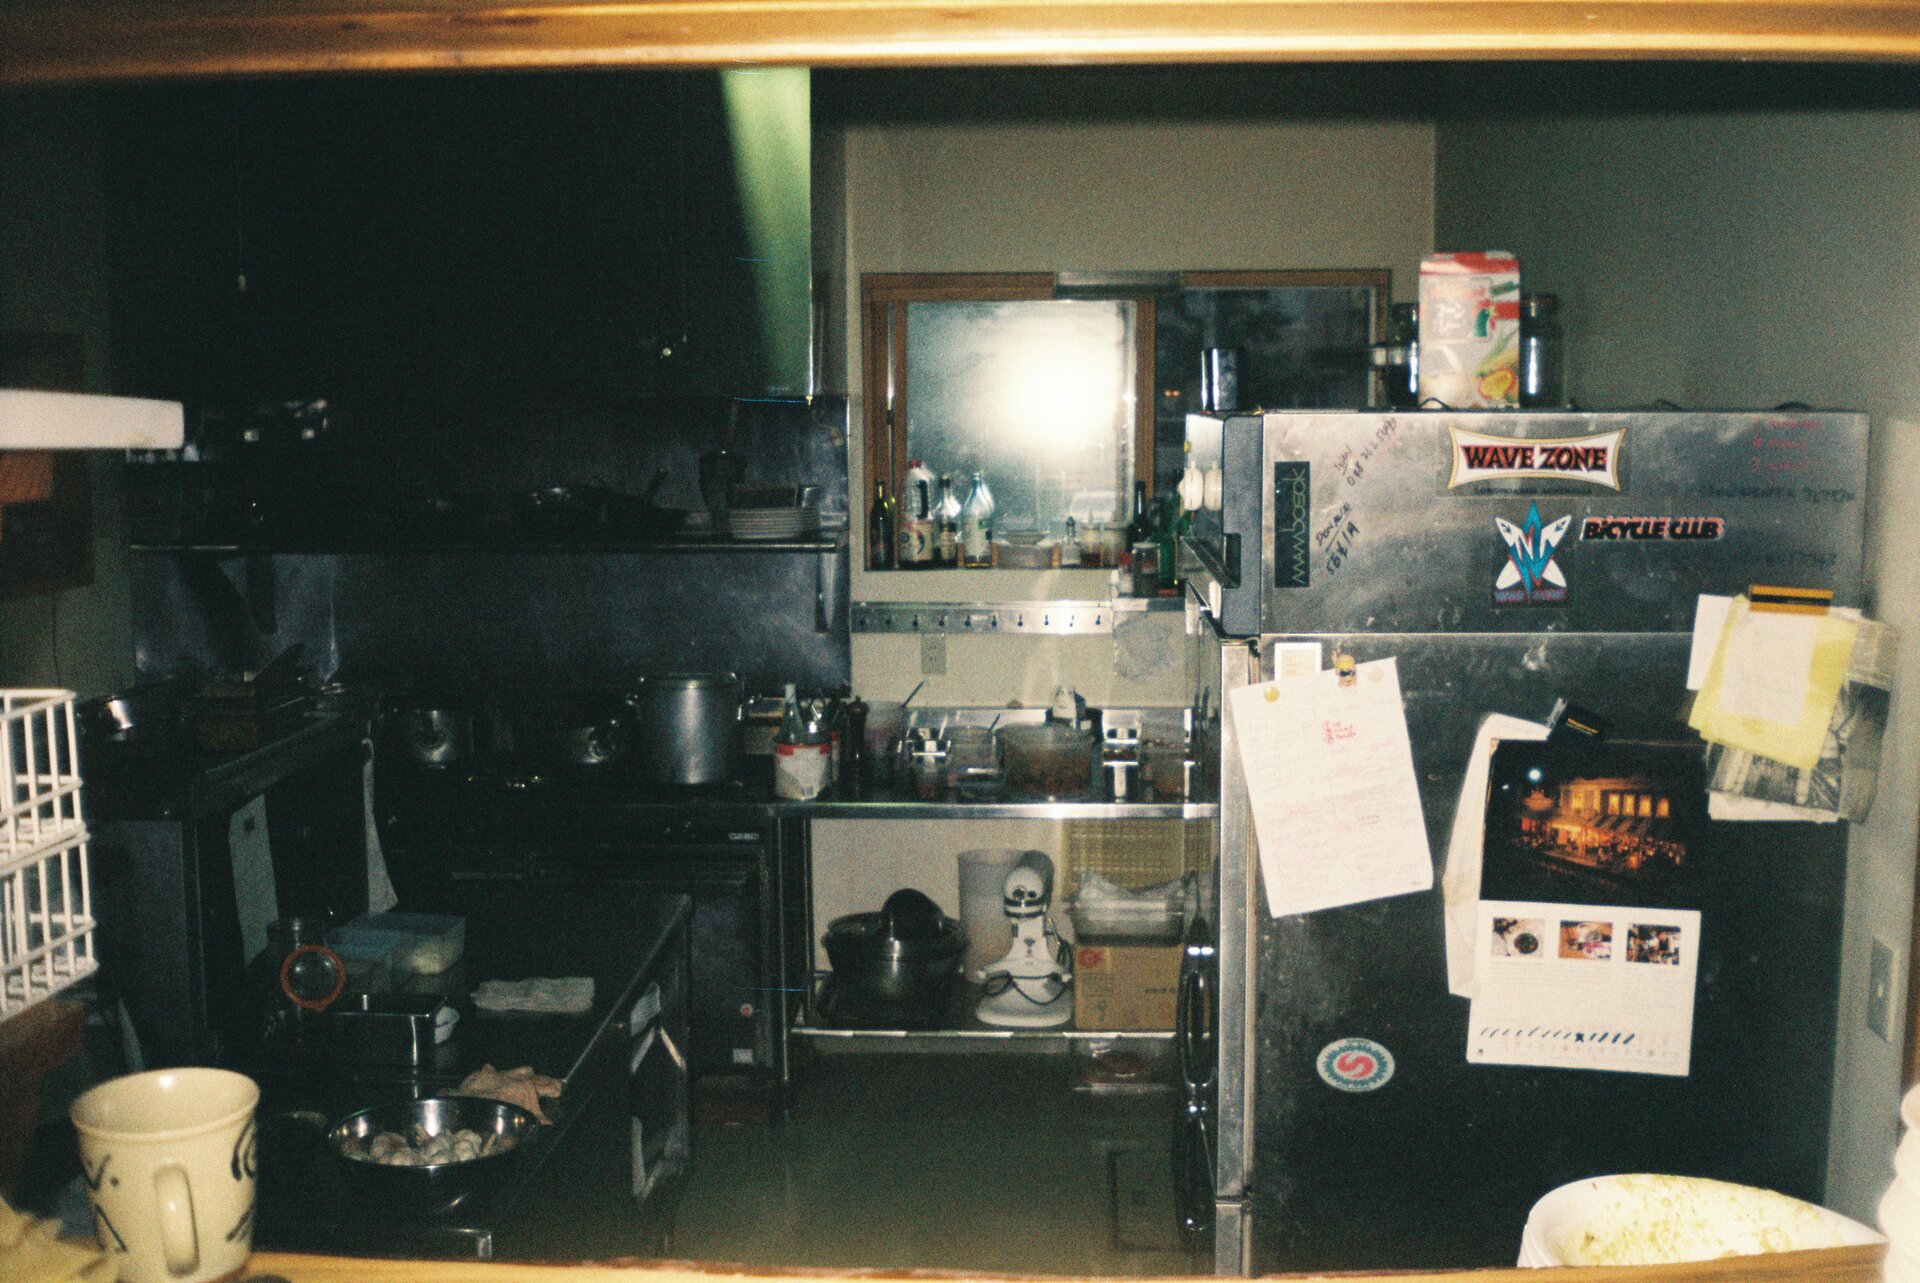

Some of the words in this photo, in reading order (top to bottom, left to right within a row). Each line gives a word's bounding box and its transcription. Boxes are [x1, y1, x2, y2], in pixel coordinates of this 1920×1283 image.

[1460, 445, 1536, 470] WAVE
[1539, 445, 1609, 473] ZONE
[1668, 517, 1724, 541] CLUB
